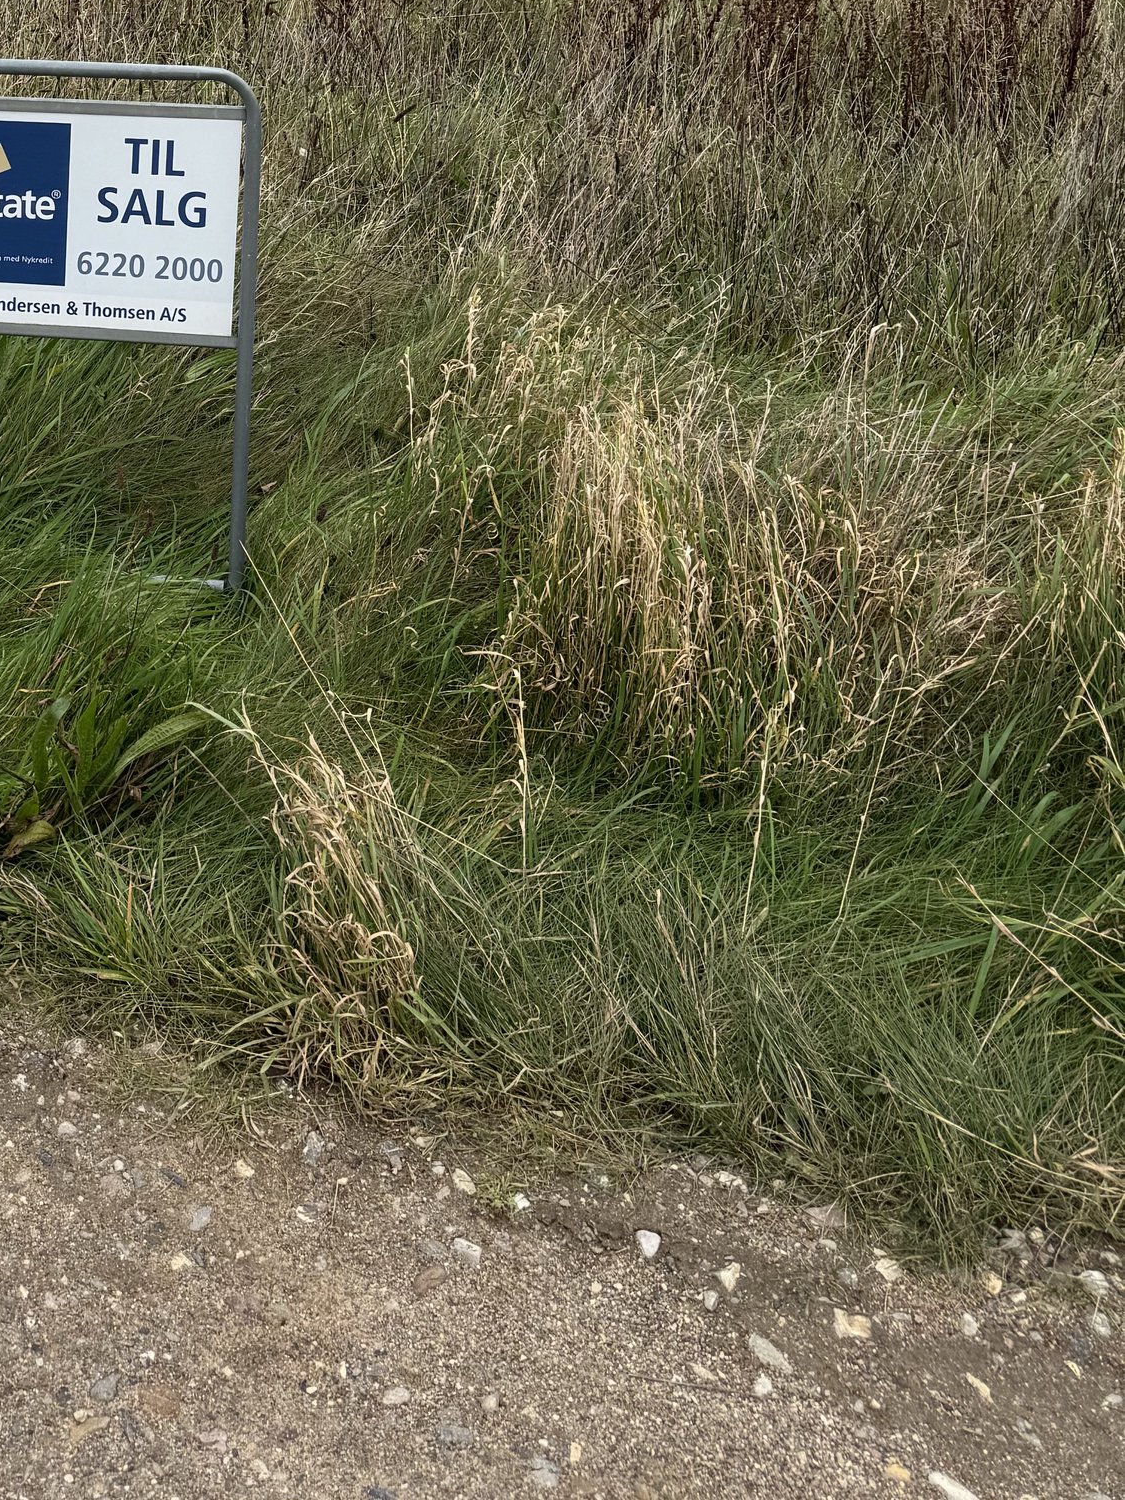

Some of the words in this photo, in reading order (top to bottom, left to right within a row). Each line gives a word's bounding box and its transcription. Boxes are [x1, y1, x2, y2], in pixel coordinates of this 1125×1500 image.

[125, 138, 186, 177] TIL
[97, 187, 207, 228] SALG
[22, 256, 53, 264] Nykredit
[77, 251, 145, 278] 6220
[155, 256, 223, 282] 2000
[66, 301, 78, 316] &
[83, 302, 155, 321] Thomsen
[160, 306, 187, 323] A/S
